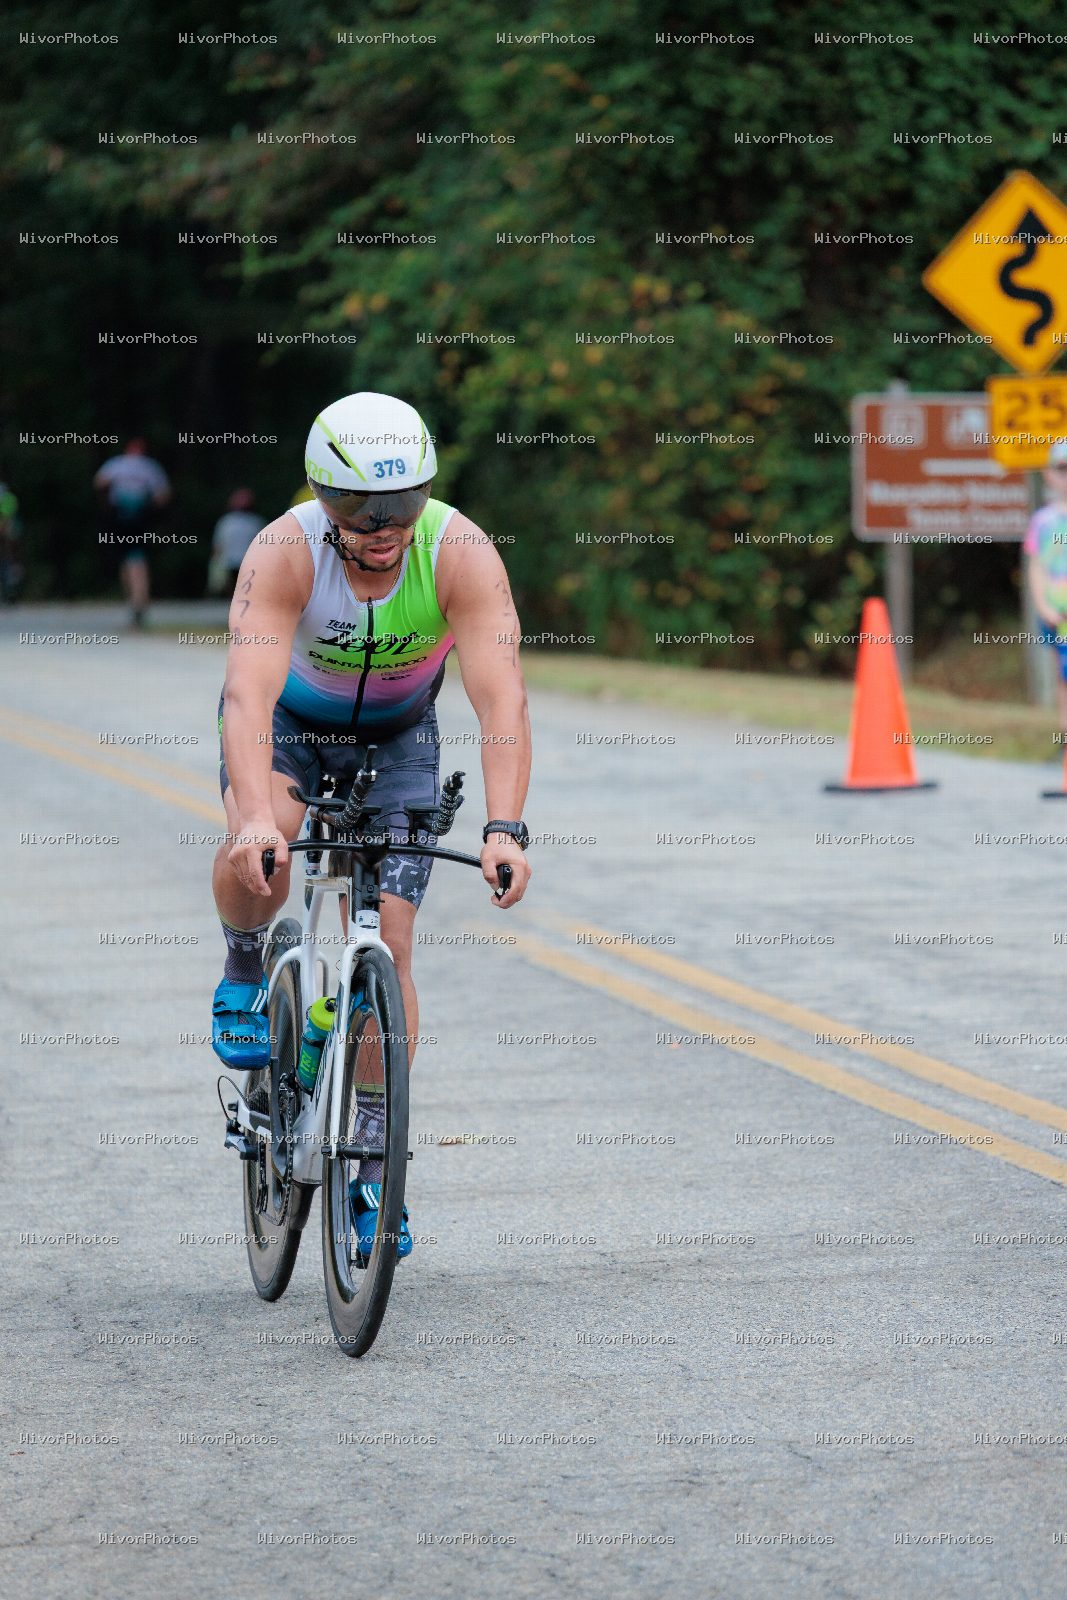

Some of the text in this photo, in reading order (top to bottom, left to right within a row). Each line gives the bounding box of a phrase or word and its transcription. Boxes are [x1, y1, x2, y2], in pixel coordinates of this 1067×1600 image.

[1004, 391, 1066, 431] 25
[373, 458, 406, 479] 379
[328, 619, 357, 631] TEAM
